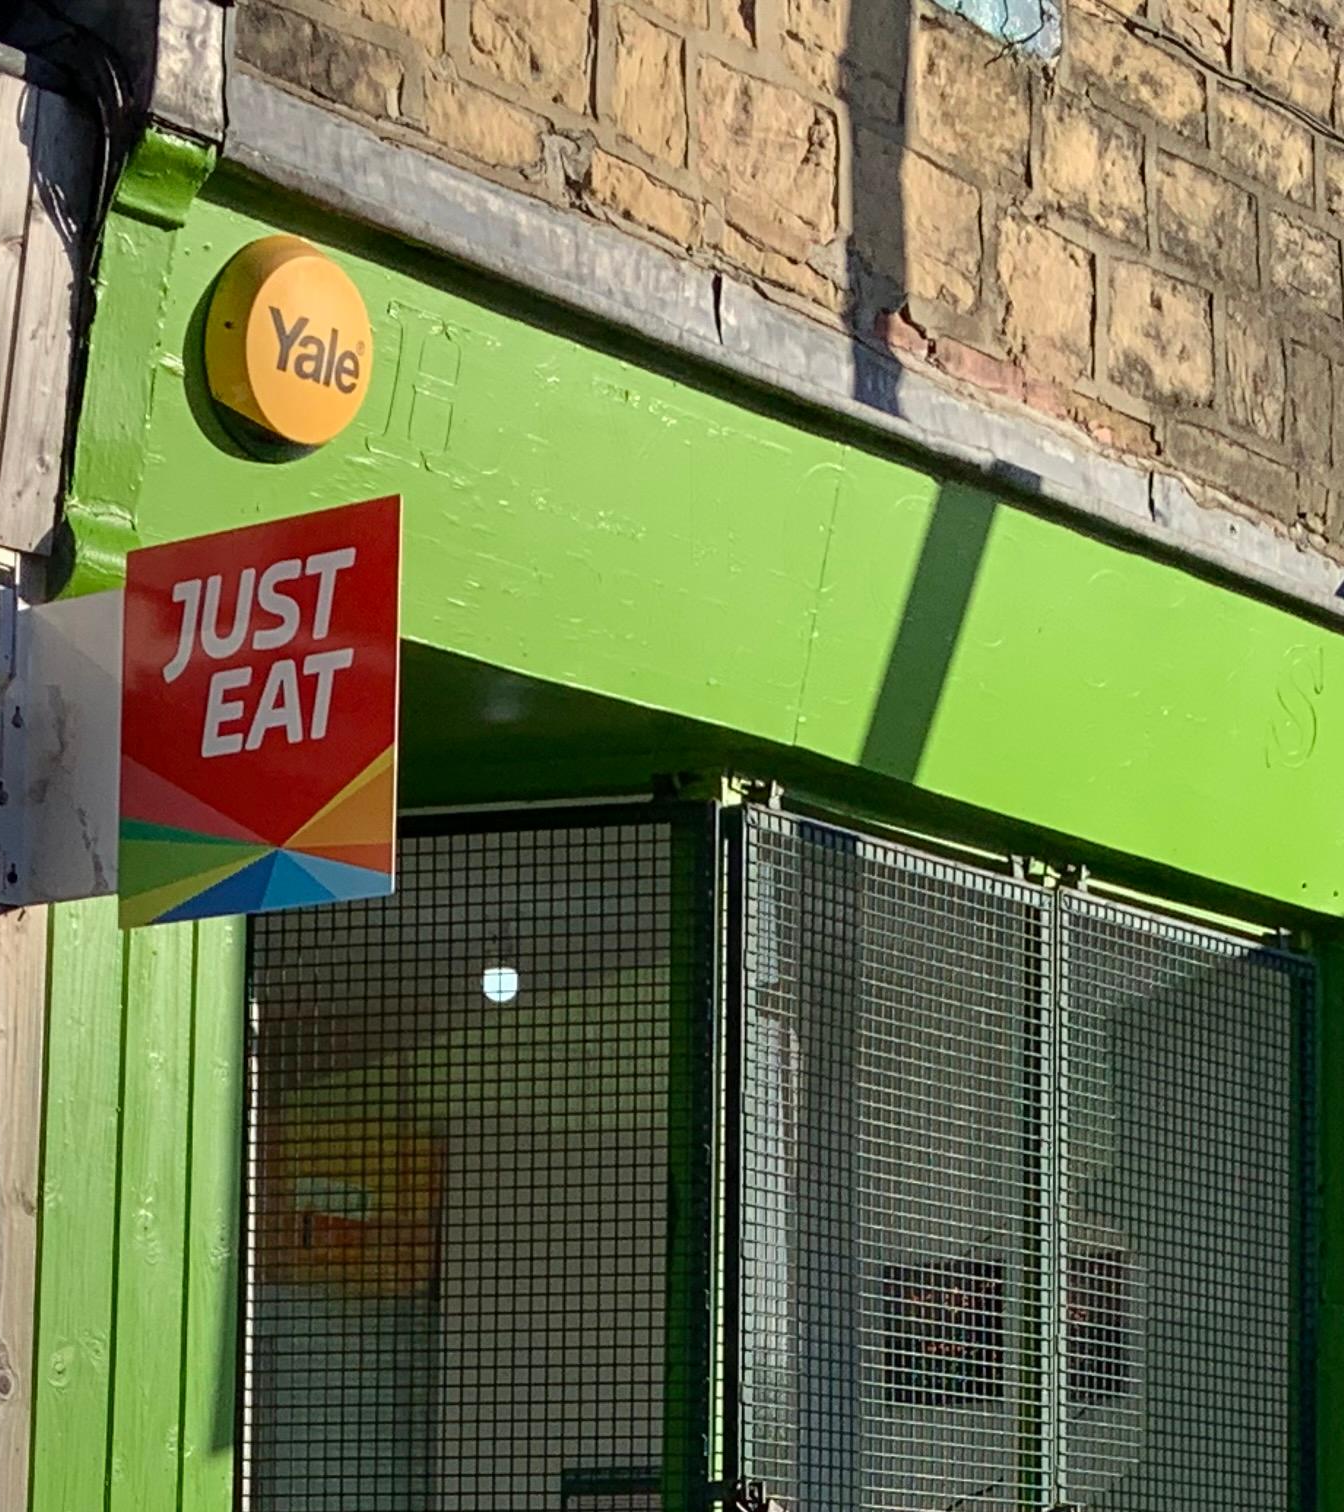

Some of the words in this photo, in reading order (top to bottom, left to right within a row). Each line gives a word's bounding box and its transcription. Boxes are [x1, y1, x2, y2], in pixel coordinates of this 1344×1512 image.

[268, 306, 359, 394] Yale
[162, 547, 356, 684] JUST
[201, 648, 354, 759] EAT
